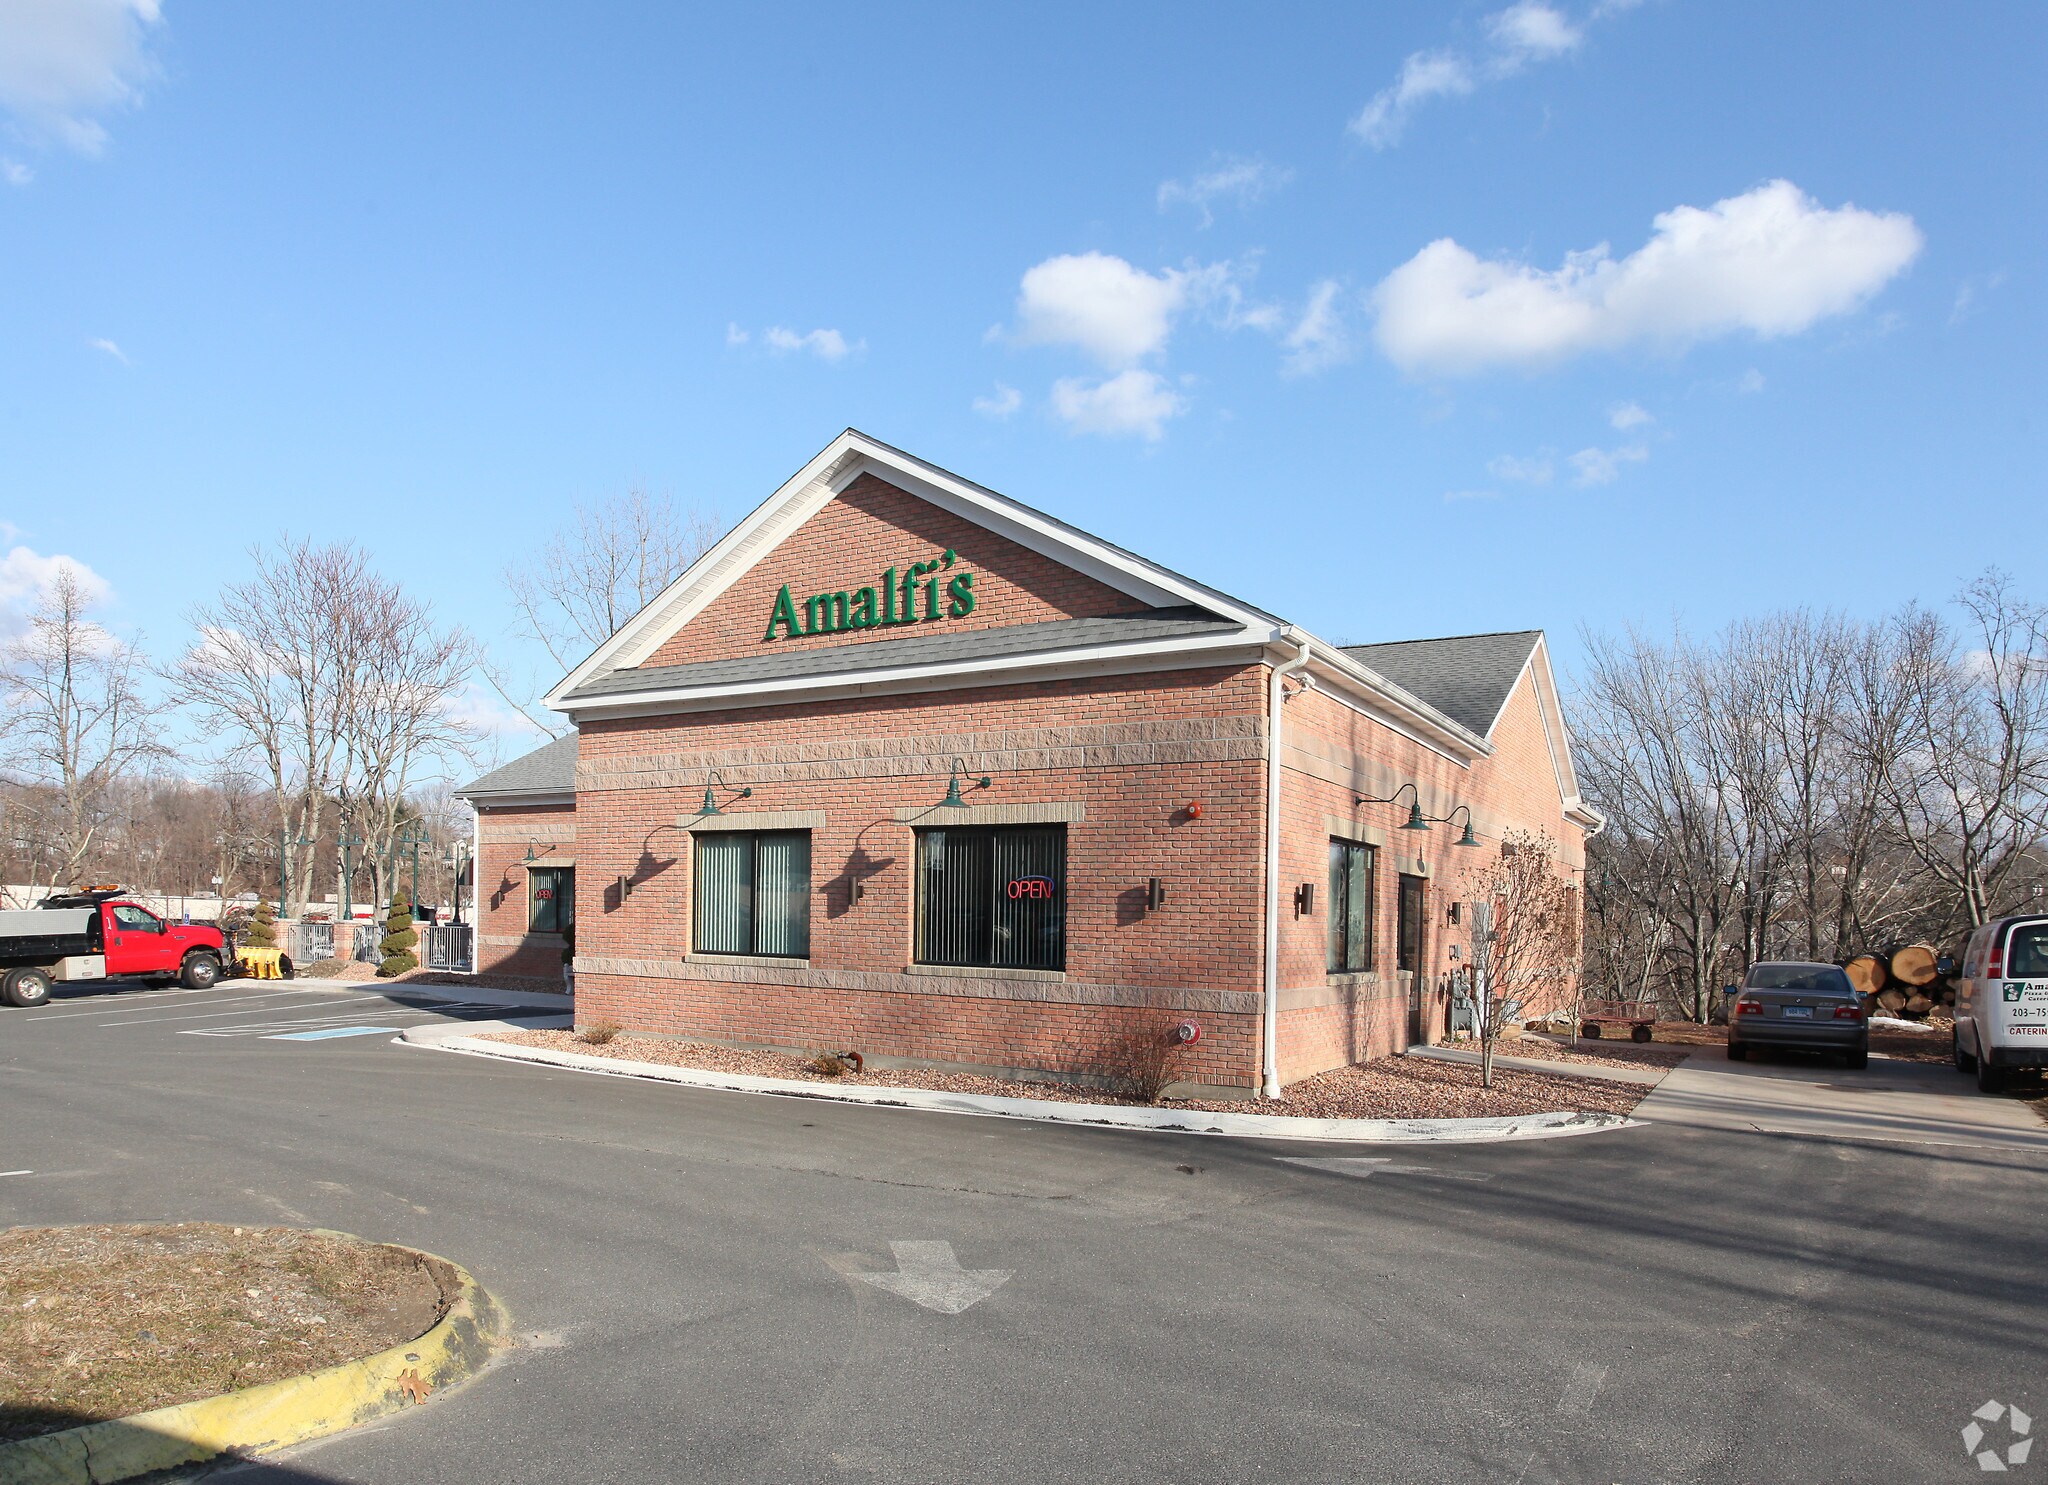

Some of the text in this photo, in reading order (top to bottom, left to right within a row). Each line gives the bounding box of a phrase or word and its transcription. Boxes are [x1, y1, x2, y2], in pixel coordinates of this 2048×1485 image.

[764, 549, 976, 639] Amalfi's
[535, 889, 553, 899] OPEN
[1007, 880, 1052, 899] OPEN
[2012, 1008, 2048, 1017] 203-75
